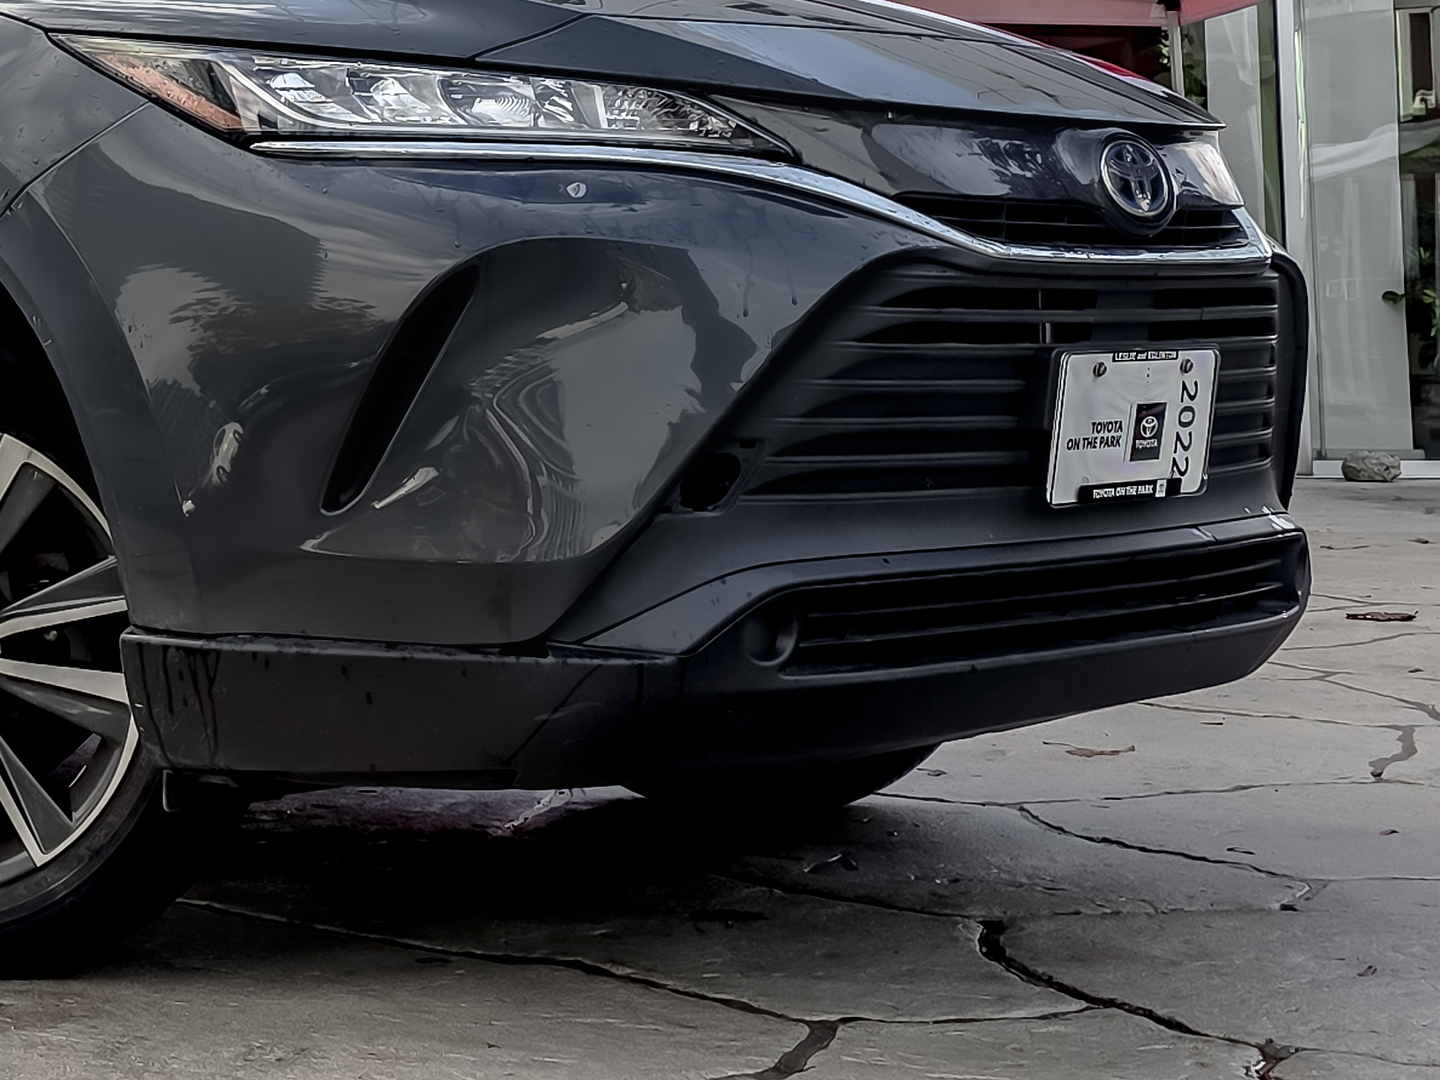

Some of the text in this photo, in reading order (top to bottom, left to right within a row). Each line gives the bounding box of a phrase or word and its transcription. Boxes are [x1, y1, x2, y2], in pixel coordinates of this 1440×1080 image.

[1091, 420, 1123, 435] TOYOTA
[1170, 380, 1199, 478] 2022
[1066, 435, 1122, 451] ON THE PARK
